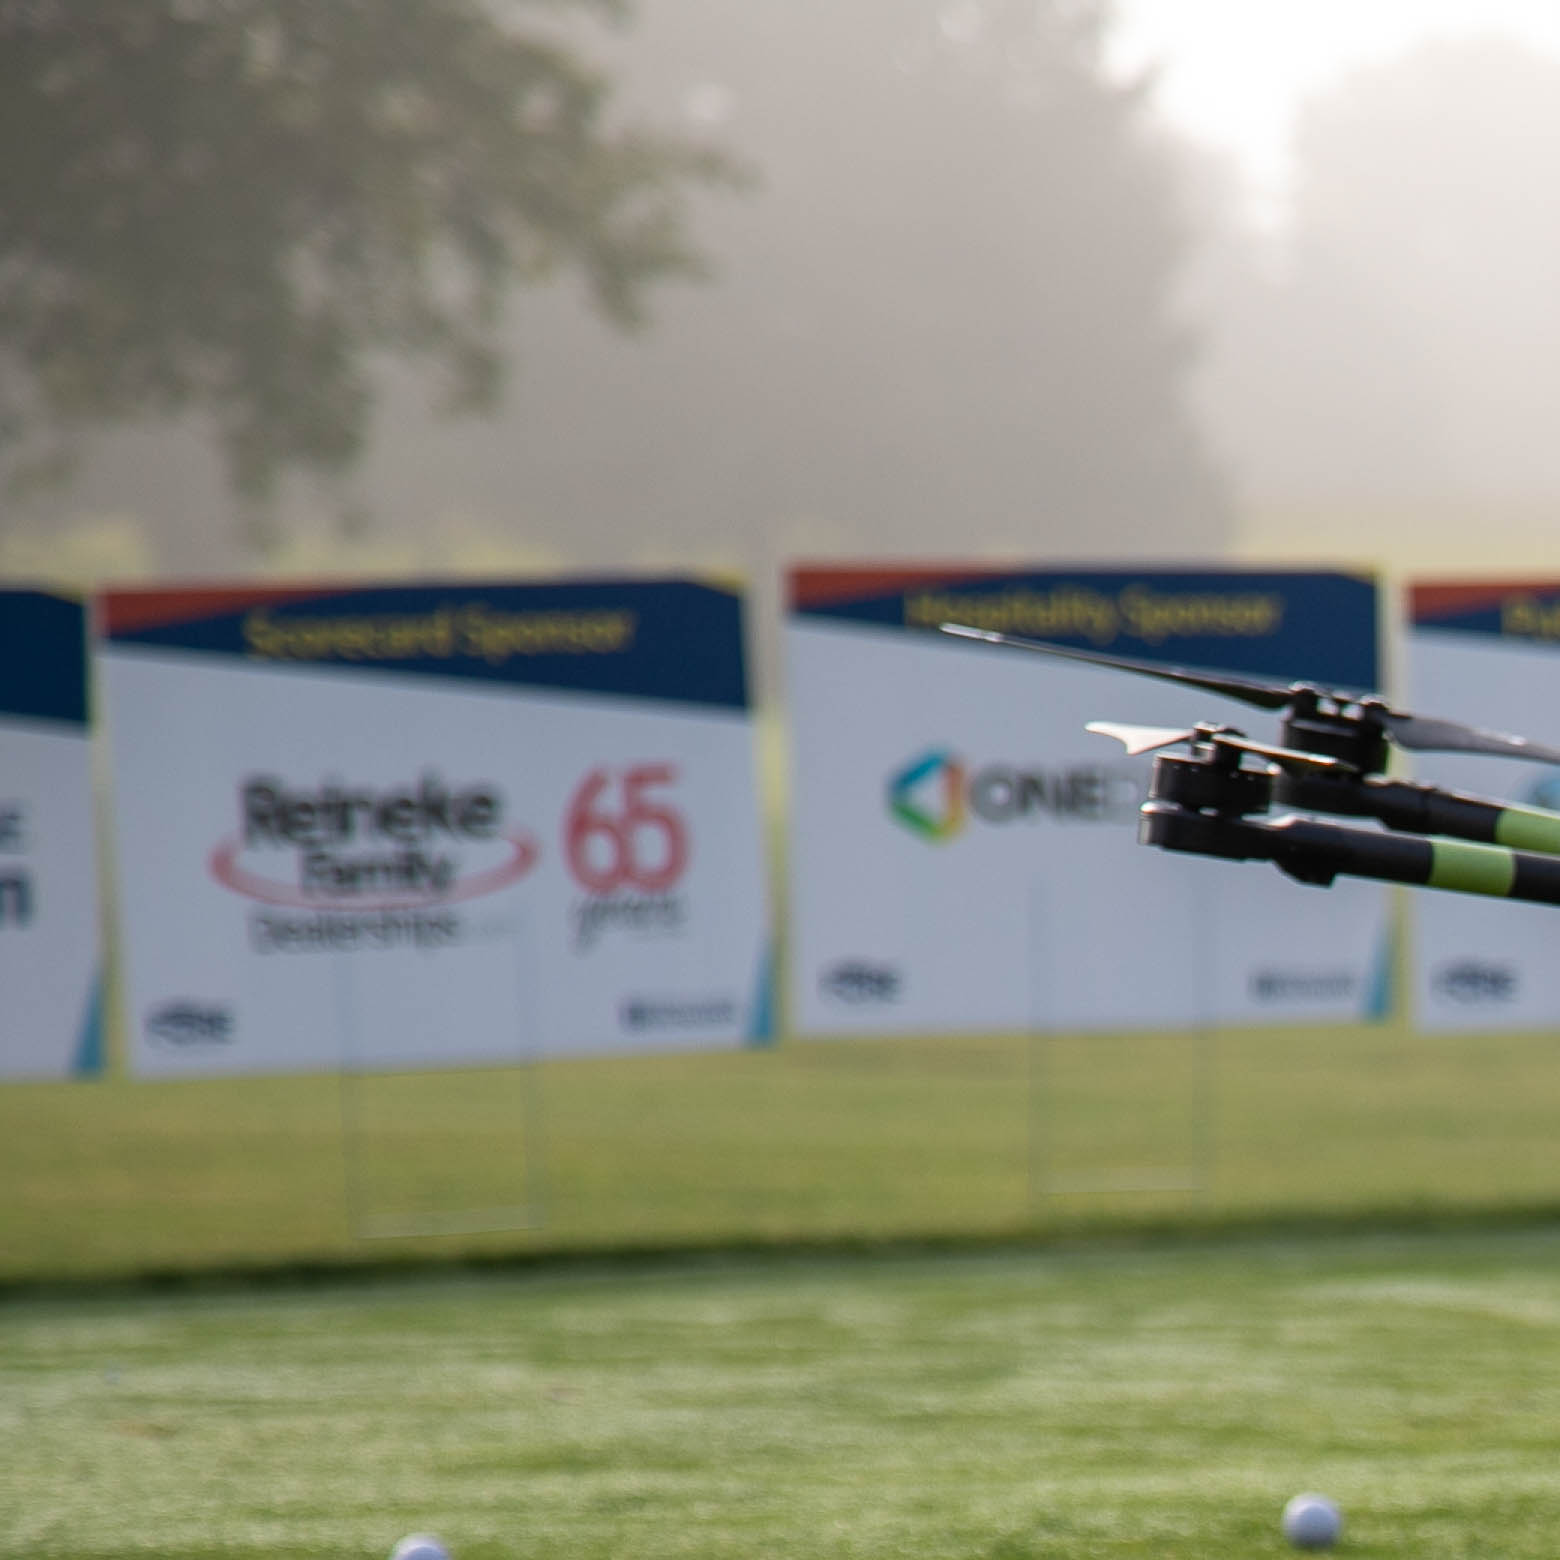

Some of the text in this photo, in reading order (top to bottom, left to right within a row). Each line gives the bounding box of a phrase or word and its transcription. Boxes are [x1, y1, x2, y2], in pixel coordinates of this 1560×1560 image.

[241, 768, 504, 848] Reineke
[564, 760, 689, 897] 65
[300, 851, 457, 898] Family
